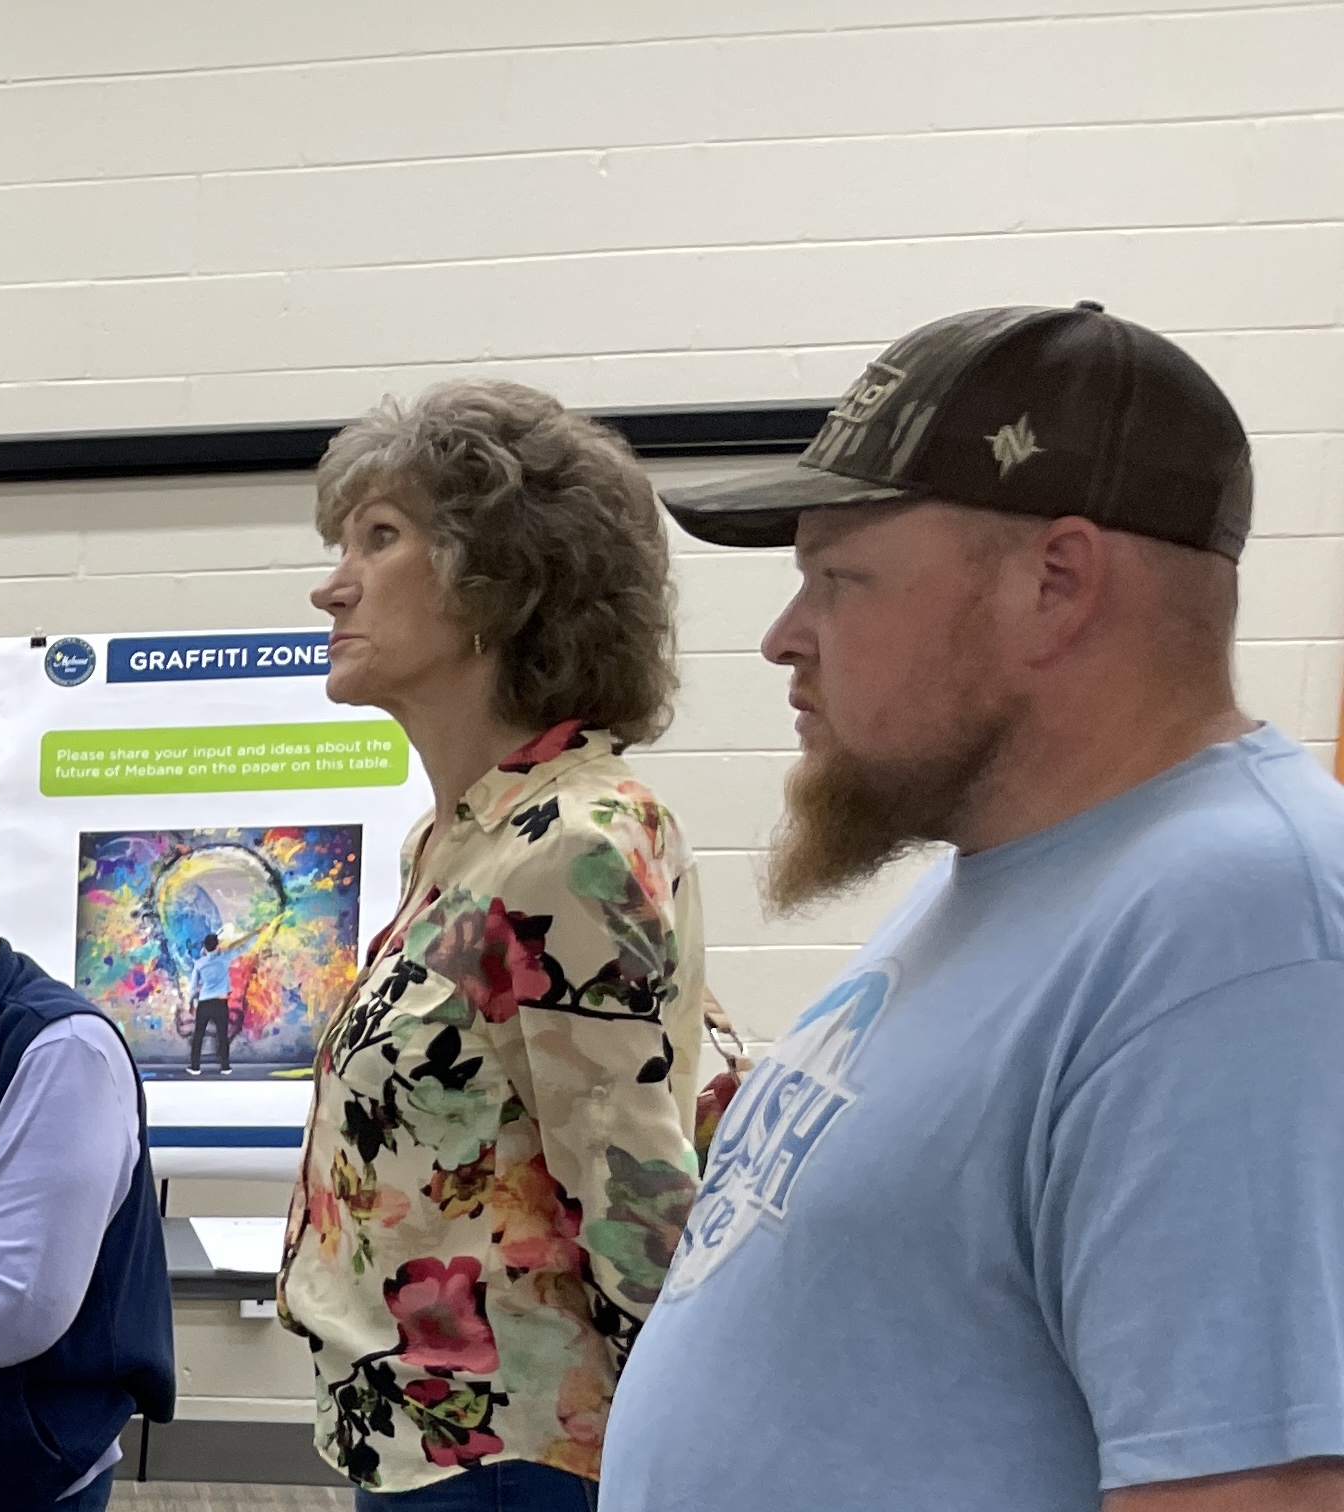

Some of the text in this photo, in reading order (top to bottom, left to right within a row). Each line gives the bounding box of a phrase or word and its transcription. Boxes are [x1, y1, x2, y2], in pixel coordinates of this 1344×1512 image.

[130, 644, 330, 671] GRAFFITI ZONE
[57, 739, 391, 762] Please share your input and ideas about the
[56, 756, 392, 778] future of Mebane on the paper on this table.
